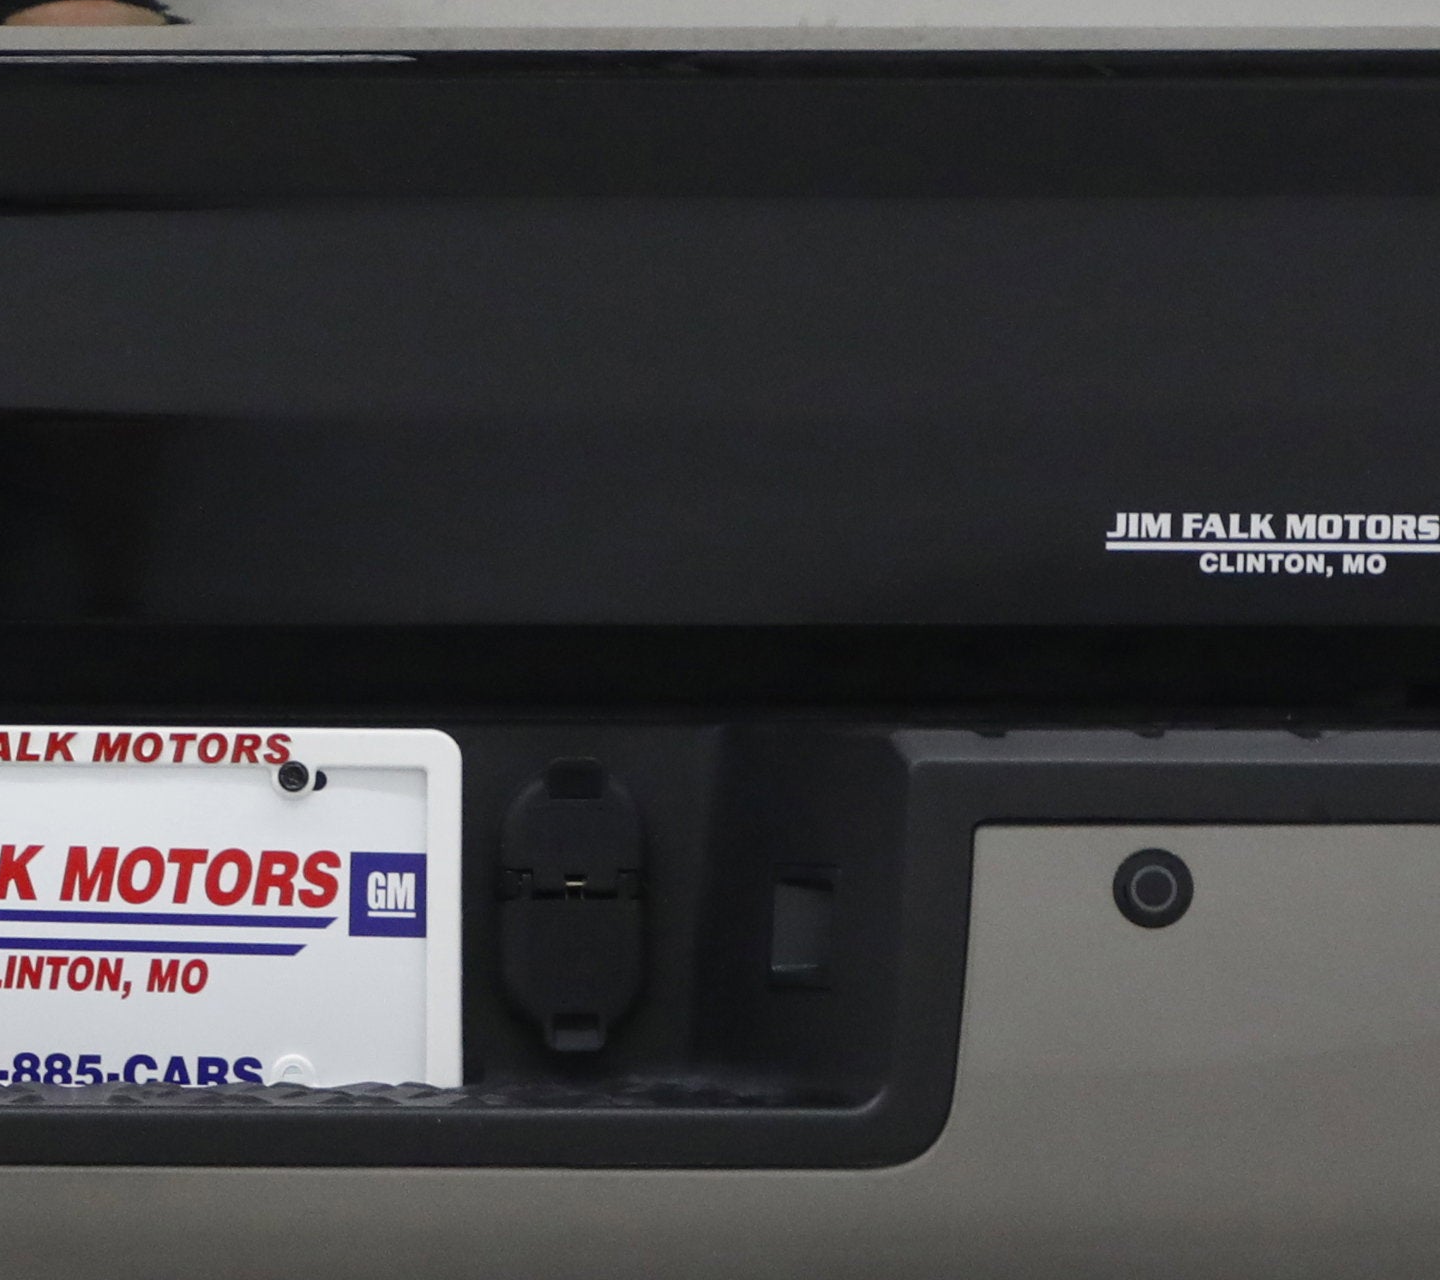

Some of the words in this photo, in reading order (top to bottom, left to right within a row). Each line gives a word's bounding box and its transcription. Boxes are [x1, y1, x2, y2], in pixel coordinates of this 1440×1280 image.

[1106, 512, 1172, 539] JIM
[1182, 513, 1274, 540] FALK
[1285, 514, 1440, 541] MOTORS
[1199, 552, 1334, 578] CLINTON,
[1342, 555, 1387, 575] MO
[92, 733, 294, 765] MOTORS
[60, 847, 341, 908] MOTORS
[366, 871, 417, 911] GM
[146, 959, 209, 994] MO
